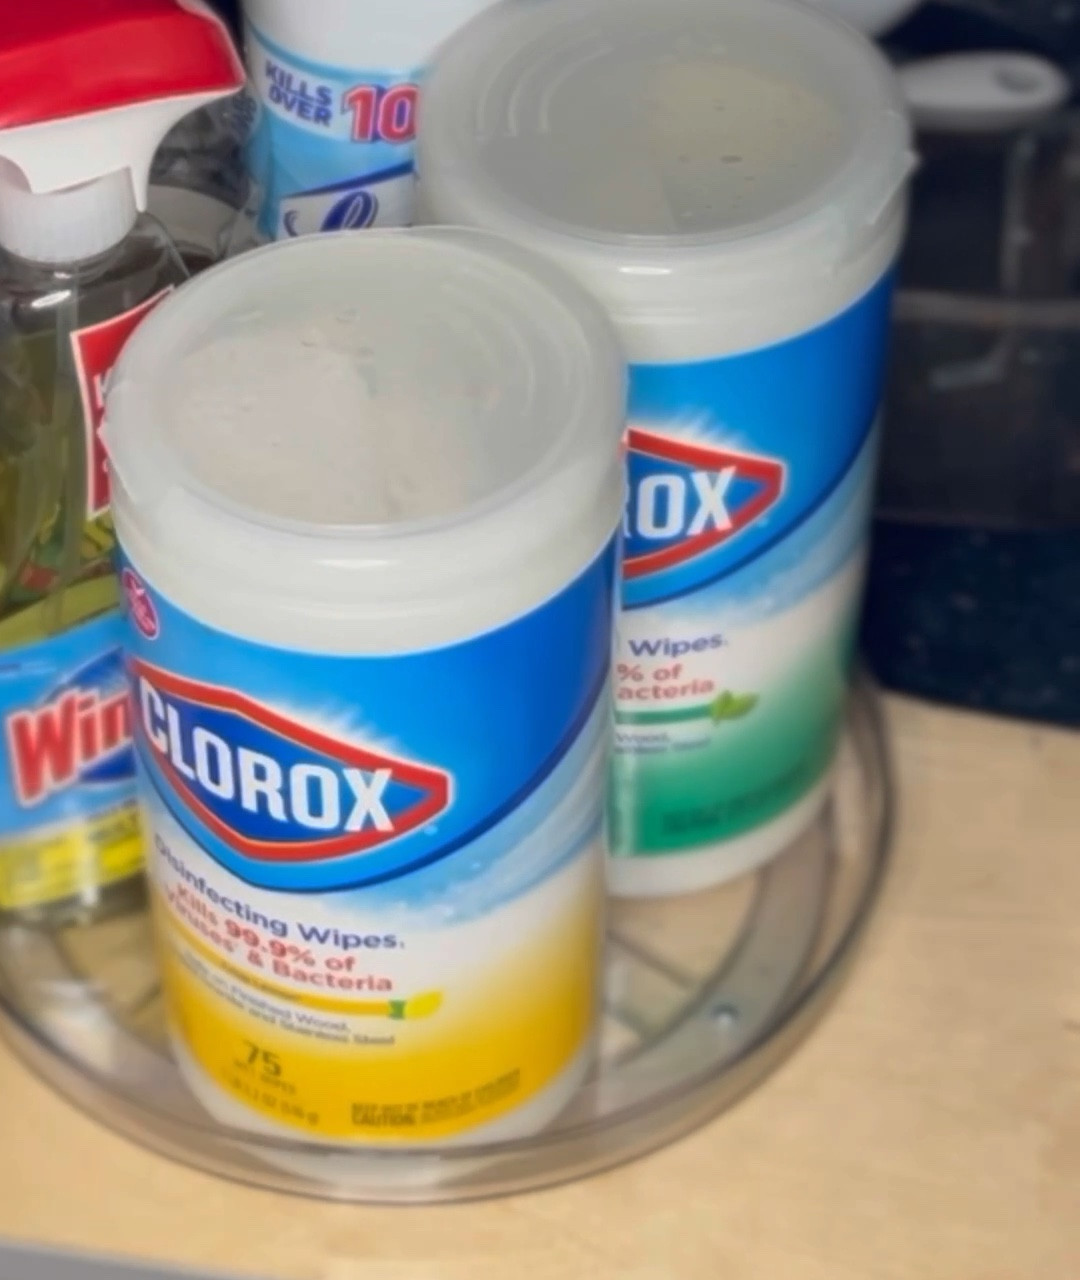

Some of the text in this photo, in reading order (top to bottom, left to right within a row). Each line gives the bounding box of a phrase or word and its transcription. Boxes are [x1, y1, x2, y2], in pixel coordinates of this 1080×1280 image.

[266, 61, 332, 106] KILLS
[269, 84, 332, 127] OVER
[617, 678, 715, 700] acteria
[652, 662, 683, 682] of
[8, 688, 133, 807] Win
[139, 675, 395, 834] CLOROX
[154, 832, 289, 938] Disinfecting
[176, 882, 219, 927] Kills
[223, 917, 316, 968] 99.9%
[324, 955, 356, 973] of
[246, 947, 265, 968] &
[271, 959, 394, 993] Bacteria
[242, 1038, 282, 1078] 75
